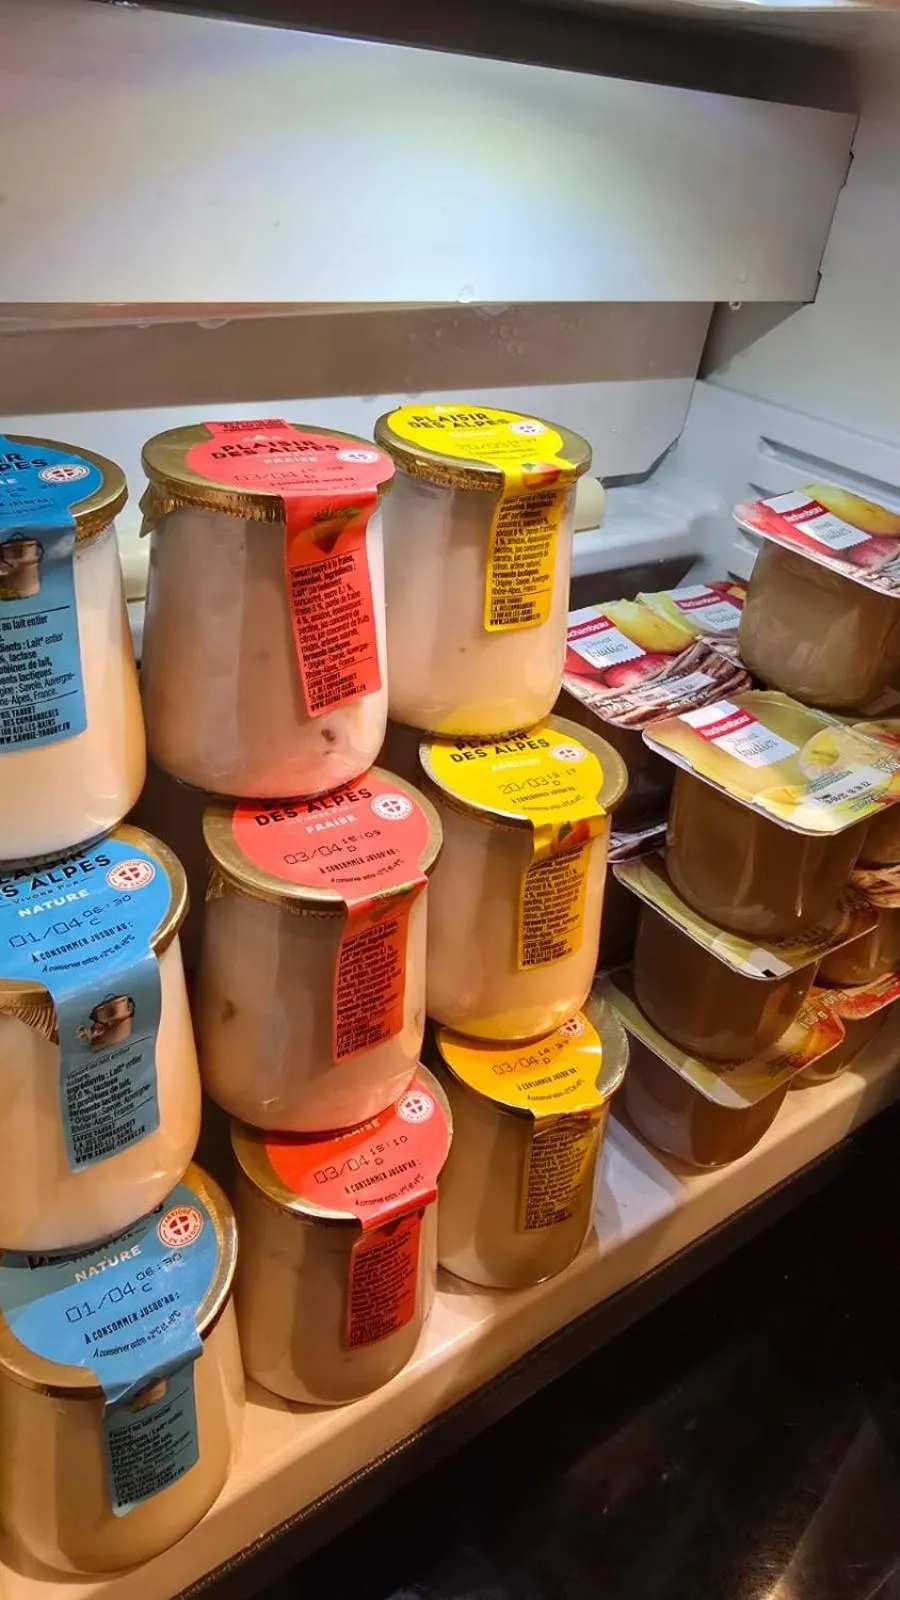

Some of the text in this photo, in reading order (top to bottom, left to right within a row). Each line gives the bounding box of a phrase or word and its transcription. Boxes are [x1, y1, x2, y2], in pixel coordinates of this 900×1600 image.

[408, 418, 510, 429] DES ALPES
[412, 412, 489, 423] PLAISIR
[211, 450, 255, 459] DES
[269, 444, 340, 454] ALPES
[221, 440, 316, 451] PLAISIR
[449, 738, 551, 763] DES ALPES
[255, 806, 298, 826] DES
[308, 788, 373, 814] ALPES
[304, 814, 358, 834] FRAISE
[283, 842, 342, 865] 03/04
[31, 854, 112, 891] ALPES
[18, 888, 91, 918] NATURE
[9, 917, 83, 948] 01/04
[39, 937, 90, 961] CONSOMMER
[491, 1055, 539, 1075] 03/04
[313, 1155, 371, 1185] 03/04
[350, 1171, 389, 1194] CONSOMMER
[74, 1244, 142, 1282] NATURE
[65, 1282, 136, 1323] 01/04
[92, 1311, 139, 1342] CONSOMMER
[139, 1294, 175, 1318] JUSQU'AU
